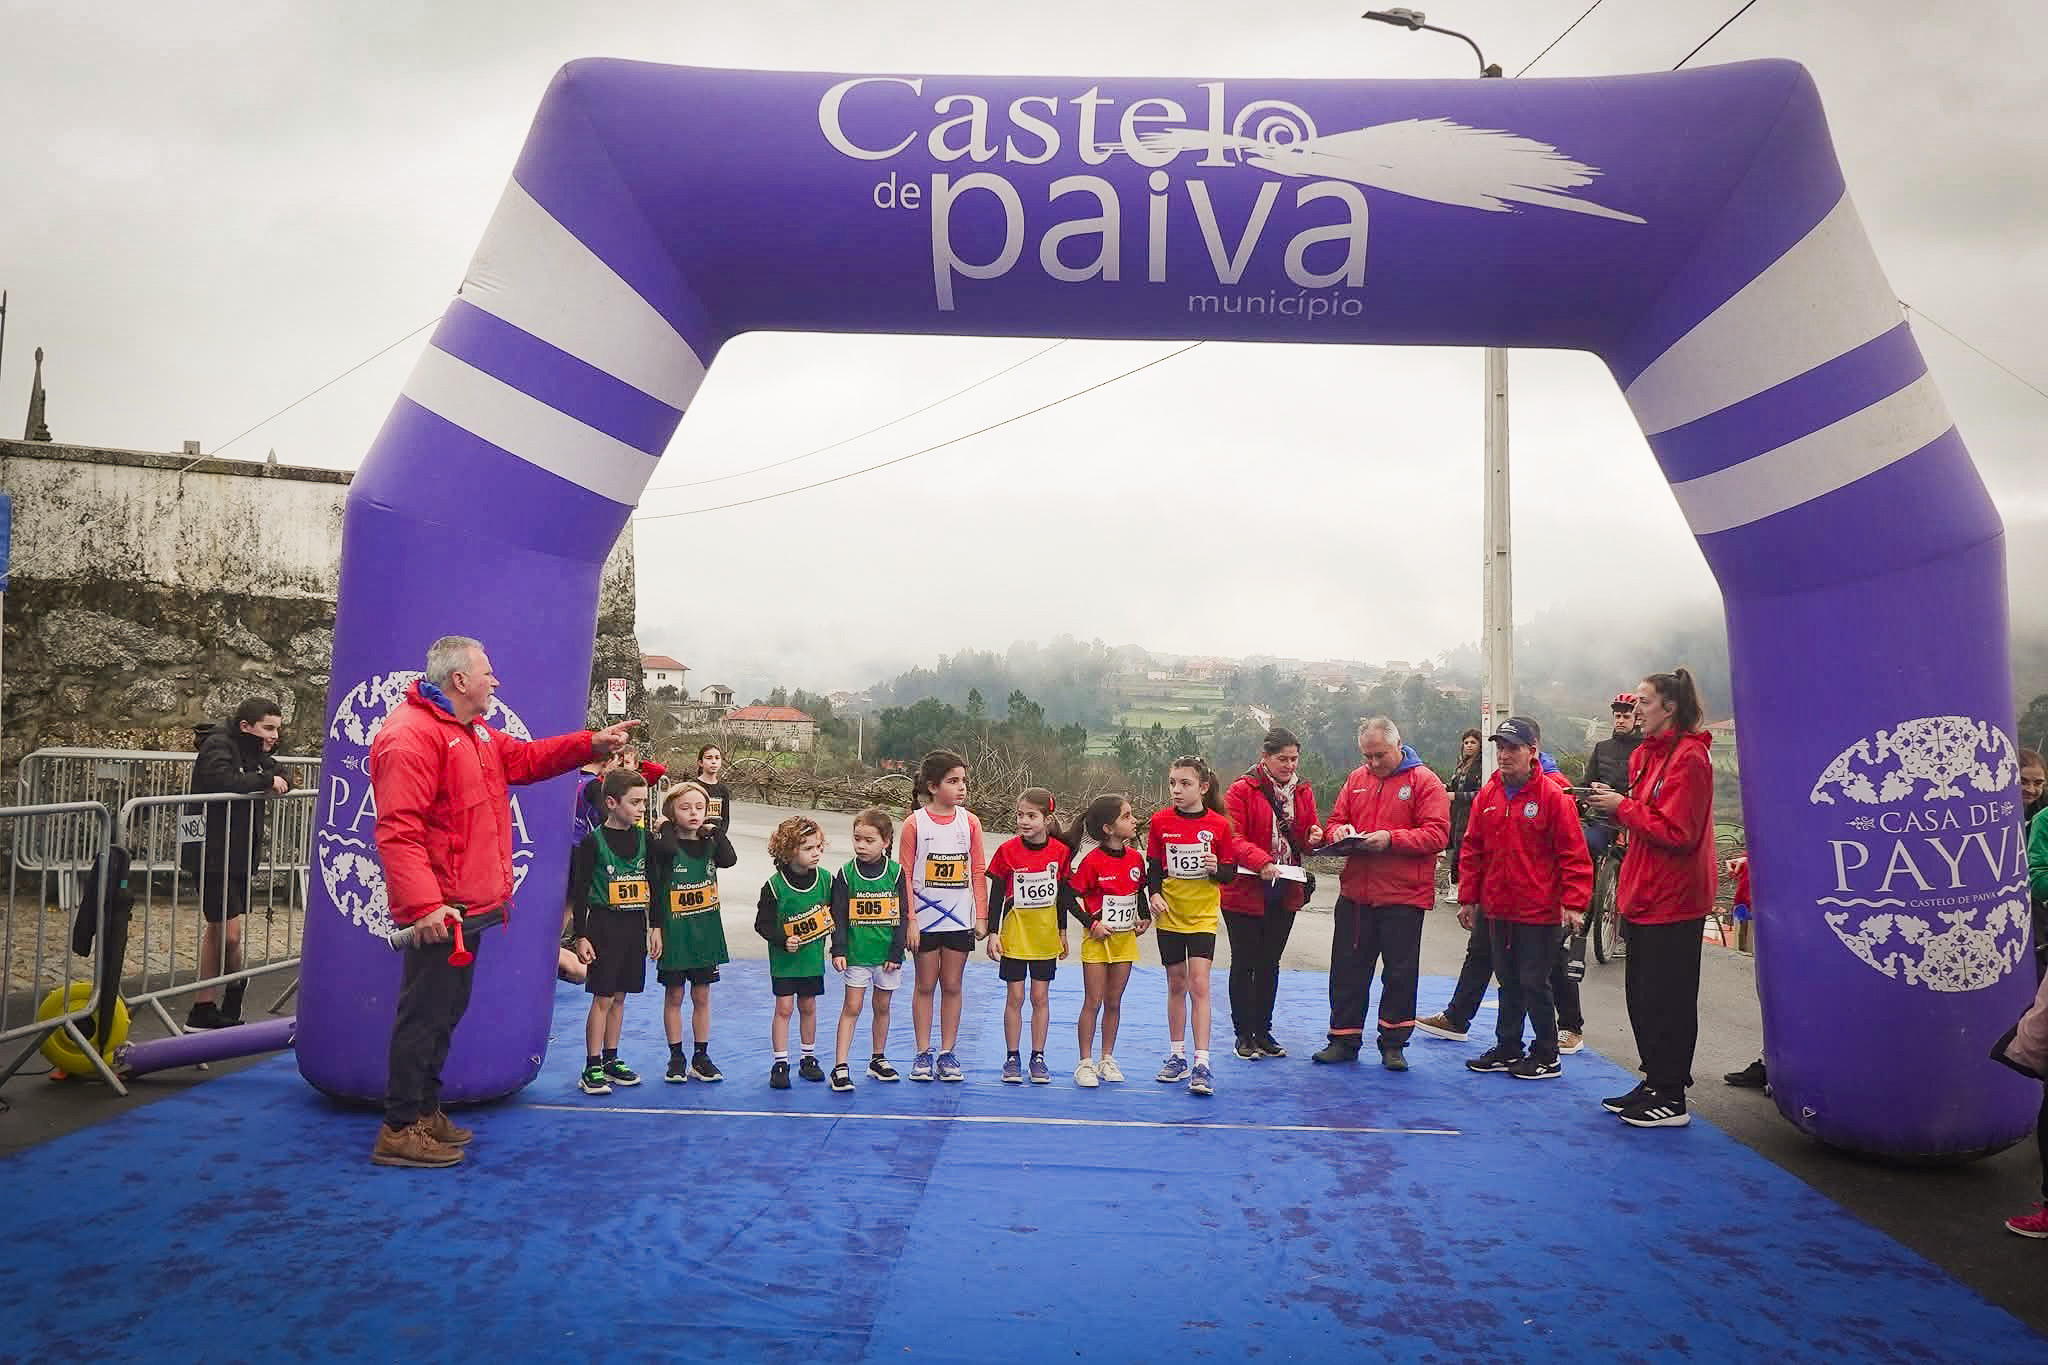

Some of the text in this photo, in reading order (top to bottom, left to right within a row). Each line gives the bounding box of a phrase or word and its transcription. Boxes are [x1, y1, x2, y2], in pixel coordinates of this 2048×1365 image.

[818, 77, 1318, 168] Castelo
[874, 168, 1371, 312] de paiva
[1187, 288, 1364, 321] município
[1879, 801, 2001, 834] CASA DE
[934, 863, 955, 878] 737
[1826, 820, 2031, 893] PAYVA
[1019, 882, 1055, 899] 1668
[1910, 897, 1956, 908] CASTELO
[856, 900, 882, 915] 505
